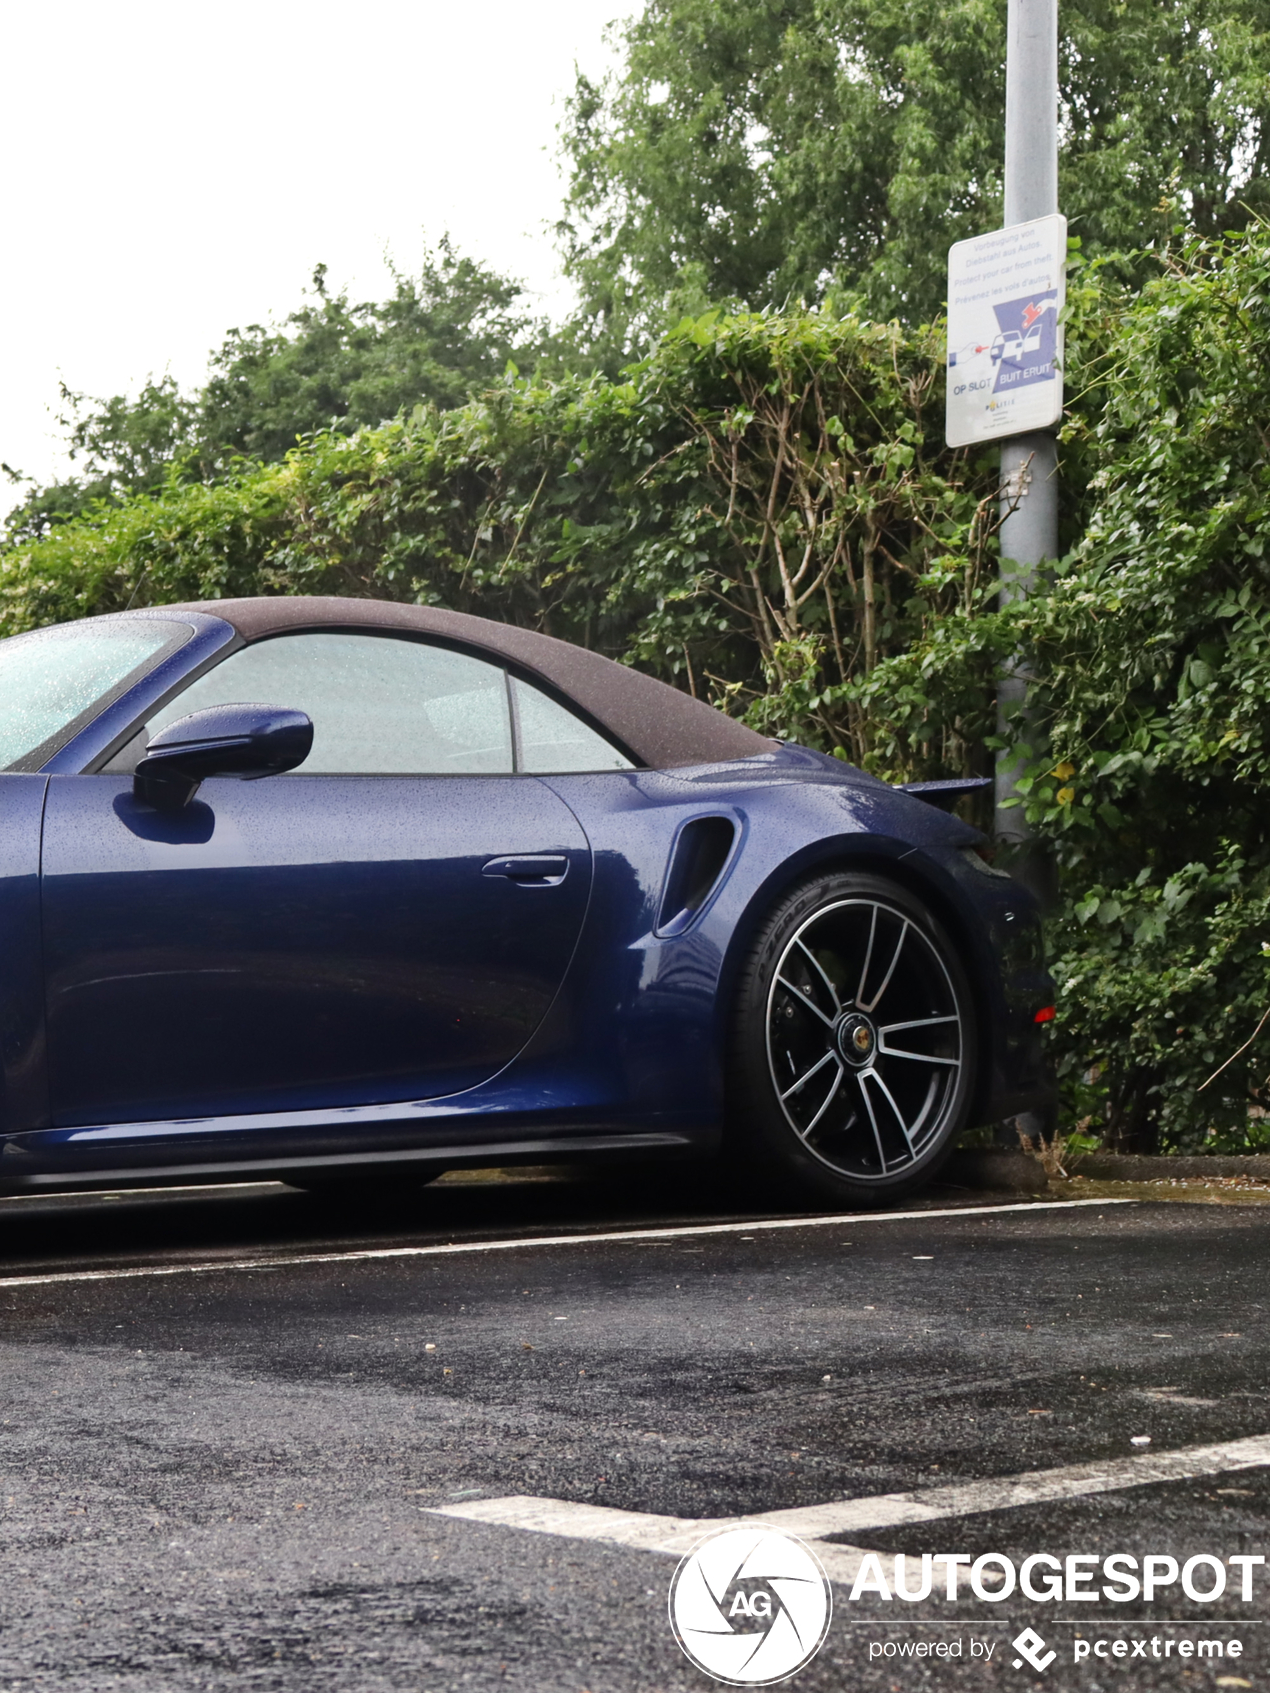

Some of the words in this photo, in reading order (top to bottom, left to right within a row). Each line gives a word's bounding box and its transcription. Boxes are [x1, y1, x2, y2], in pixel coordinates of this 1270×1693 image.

[974, 233, 1019, 252] Vorbeugung
[1021, 229, 1035, 238] von
[966, 251, 1001, 268] Diebstahl
[1003, 248, 1017, 258] aus
[954, 273, 981, 287] Protect
[982, 269, 999, 281] your
[1001, 266, 1013, 275] car
[1015, 260, 1032, 271] from
[955, 290, 990, 306] Prévenez
[992, 286, 1003, 296] les
[999, 370, 1022, 385] BUIT
[1023, 362, 1051, 379] ERUIT
[953, 383, 967, 396] OP
[968, 377, 992, 392] SLOT
